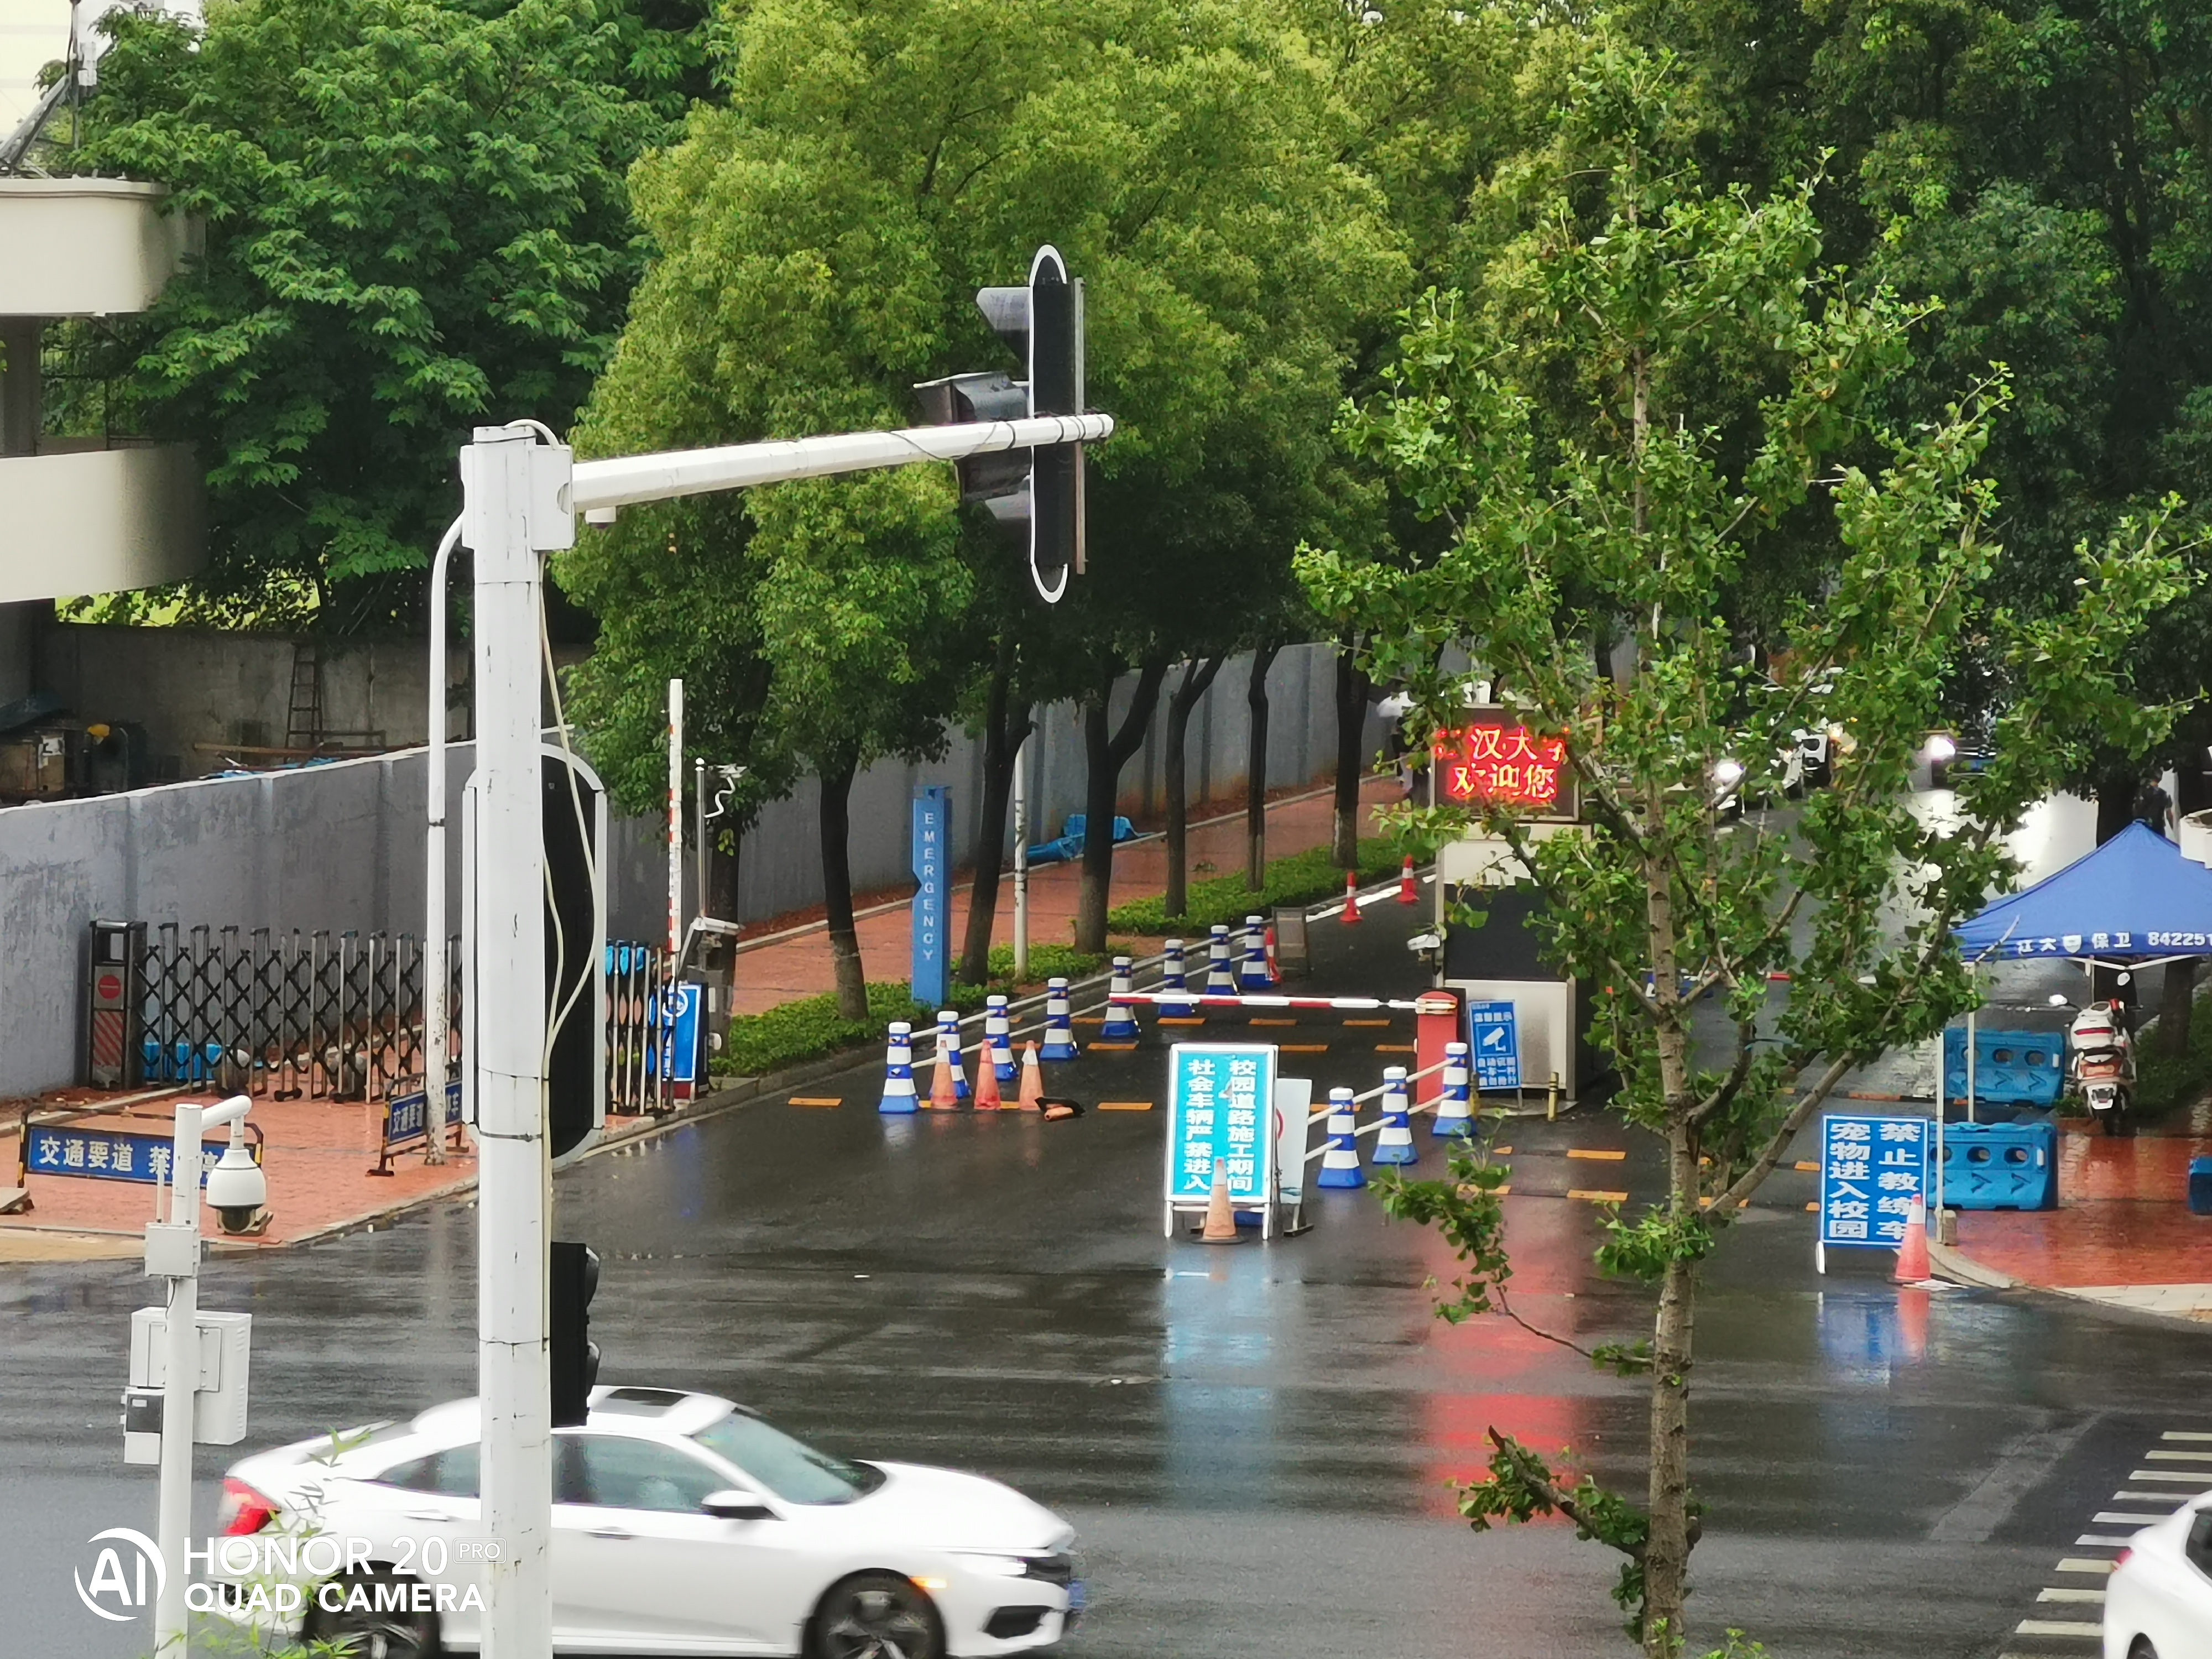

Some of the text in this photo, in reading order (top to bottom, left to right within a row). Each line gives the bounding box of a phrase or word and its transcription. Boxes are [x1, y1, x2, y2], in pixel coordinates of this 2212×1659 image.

[1453, 763, 1555, 798] 欢迎您
[923, 812, 936, 961] EMERGENCY
[2091, 932, 2132, 950] 保卫
[39, 1136, 133, 1172] 交通要道
[1183, 1058, 1215, 1191] 社会车辆严禁进入
[1226, 1059, 1256, 1192] 校园道路施工期间
[1828, 1122, 1871, 1239] 宠物进入校园
